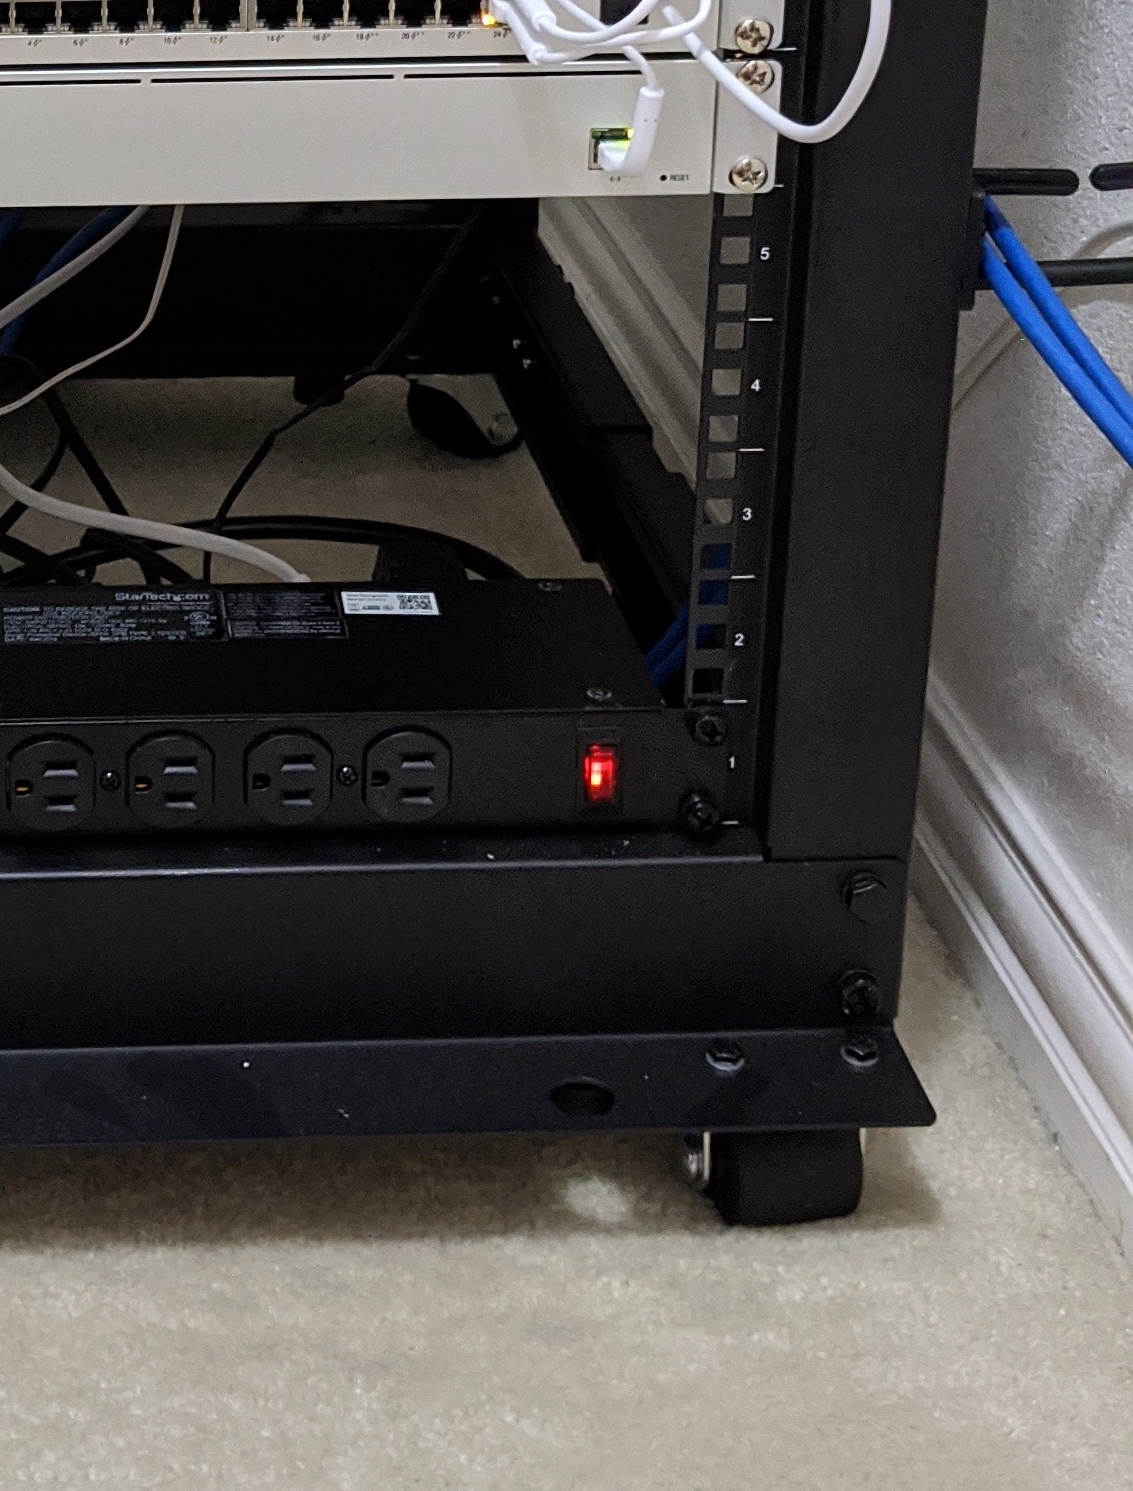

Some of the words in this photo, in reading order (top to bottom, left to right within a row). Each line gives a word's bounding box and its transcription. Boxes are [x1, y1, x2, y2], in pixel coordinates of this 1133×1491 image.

[760, 246, 770, 261] 5
[750, 378, 761, 392] 4
[742, 507, 752, 521] 3
[734, 633, 745, 647] 2
[728, 756, 736, 770] 1
